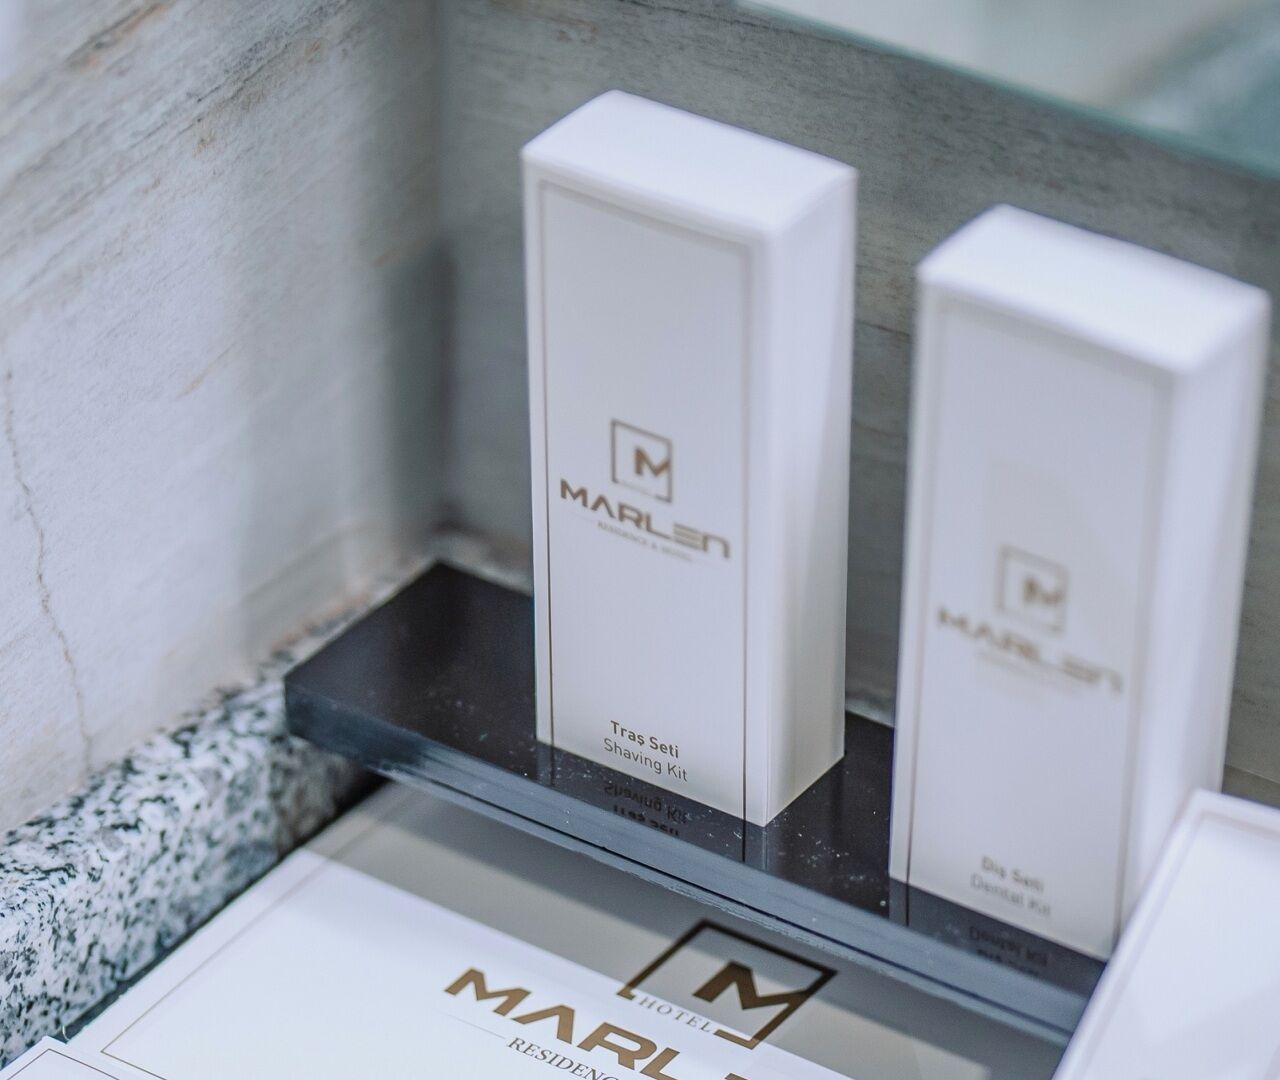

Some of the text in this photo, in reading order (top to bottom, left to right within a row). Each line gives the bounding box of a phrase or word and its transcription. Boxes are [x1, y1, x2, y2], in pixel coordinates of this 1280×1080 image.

[610, 720, 679, 758] Traş Seti
[603, 738, 688, 782] Shaving Kit
[639, 994, 716, 1033] HOTEL
